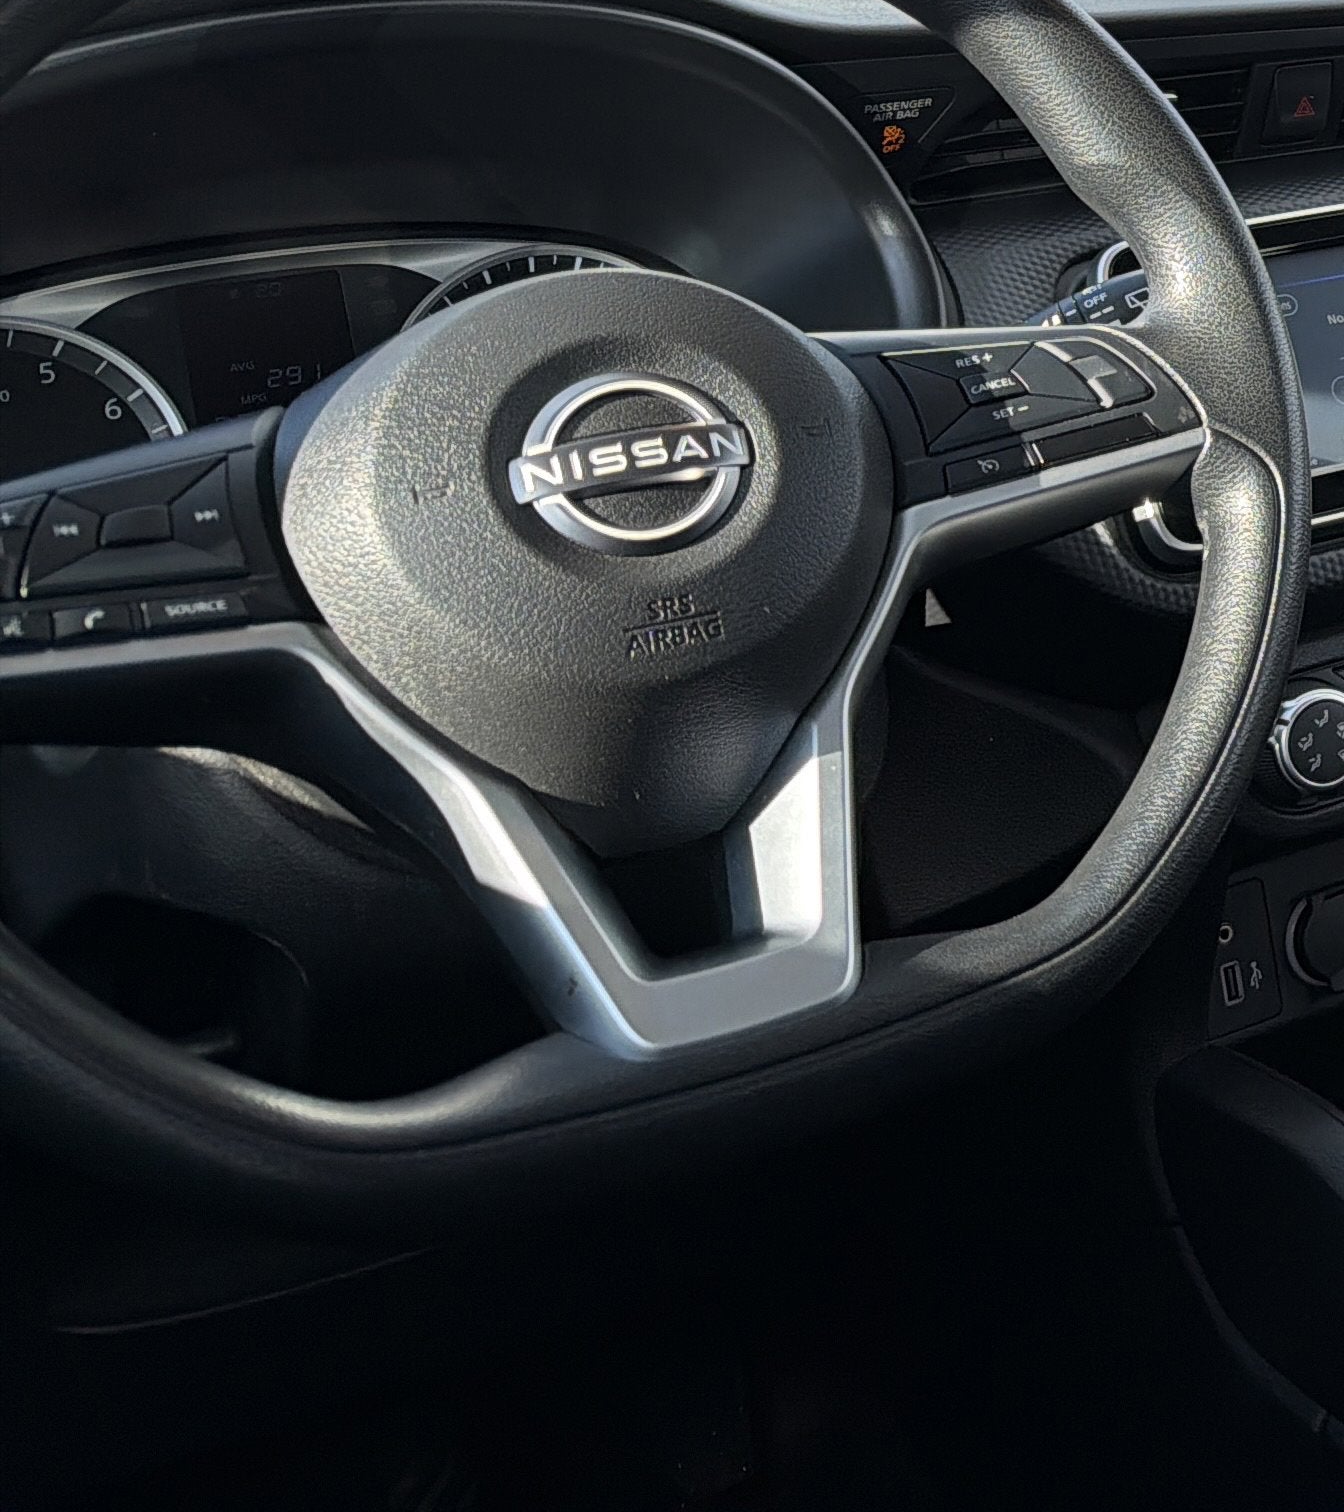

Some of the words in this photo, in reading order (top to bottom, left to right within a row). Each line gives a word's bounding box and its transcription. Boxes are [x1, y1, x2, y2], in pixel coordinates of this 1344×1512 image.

[864, 97, 933, 114] PASSENGER
[873, 111, 894, 122] AIR
[896, 108, 920, 120] BAG
[1083, 292, 1108, 308] OFF
[1326, 311, 1344, 325] No
[230, 361, 256, 372] AVG
[955, 354, 981, 368] RES
[39, 362, 56, 384] 5
[970, 377, 1016, 395] CANCEL
[104, 397, 122, 420] 6
[992, 406, 1015, 420] SET
[519, 429, 744, 493] NISSAN
[164, 599, 228, 617] SOURCE
[646, 593, 697, 621] SRS
[629, 616, 725, 658] AIRBAG
